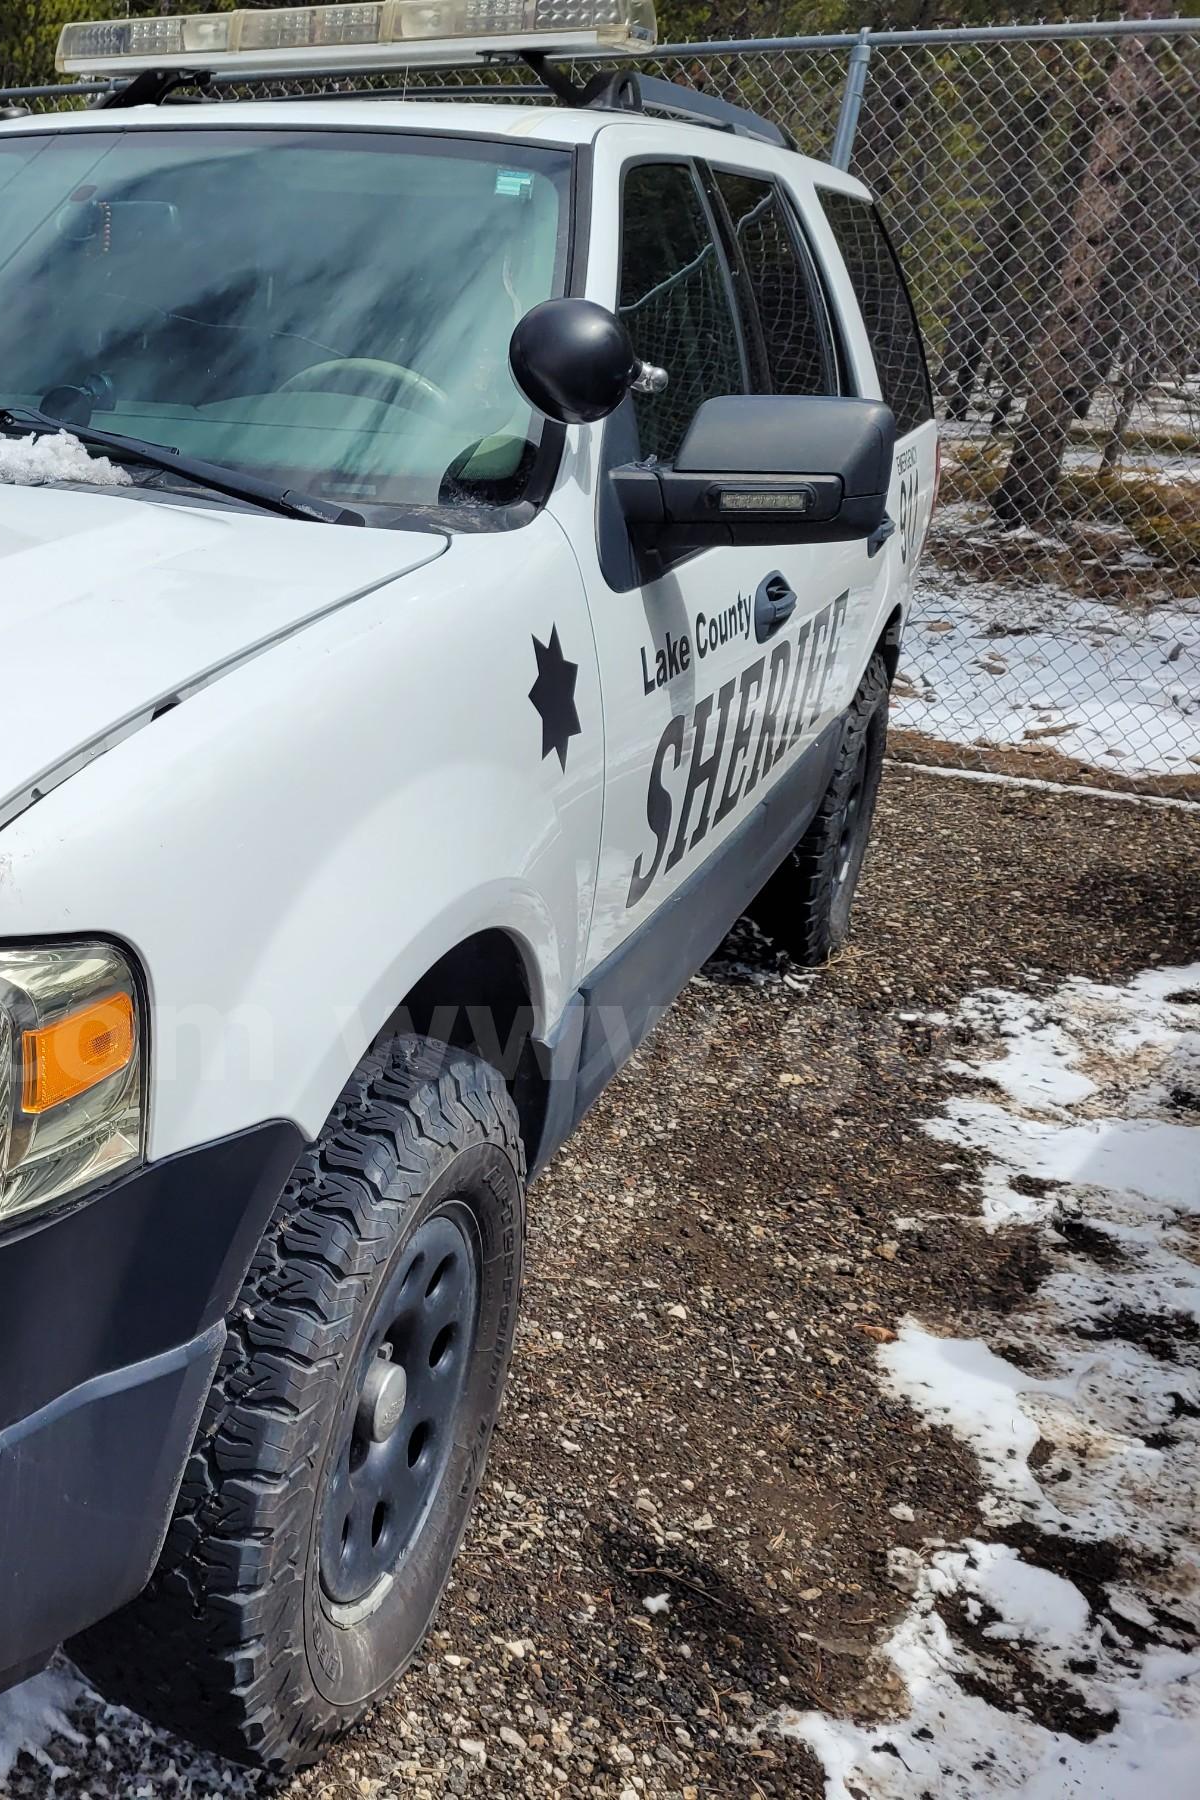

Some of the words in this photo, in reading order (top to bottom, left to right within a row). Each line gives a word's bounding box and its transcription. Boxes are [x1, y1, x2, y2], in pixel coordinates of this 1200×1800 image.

[625, 589, 850, 908] SHERIFF
[640, 632, 690, 697] Lake
[695, 592, 753, 659] County
